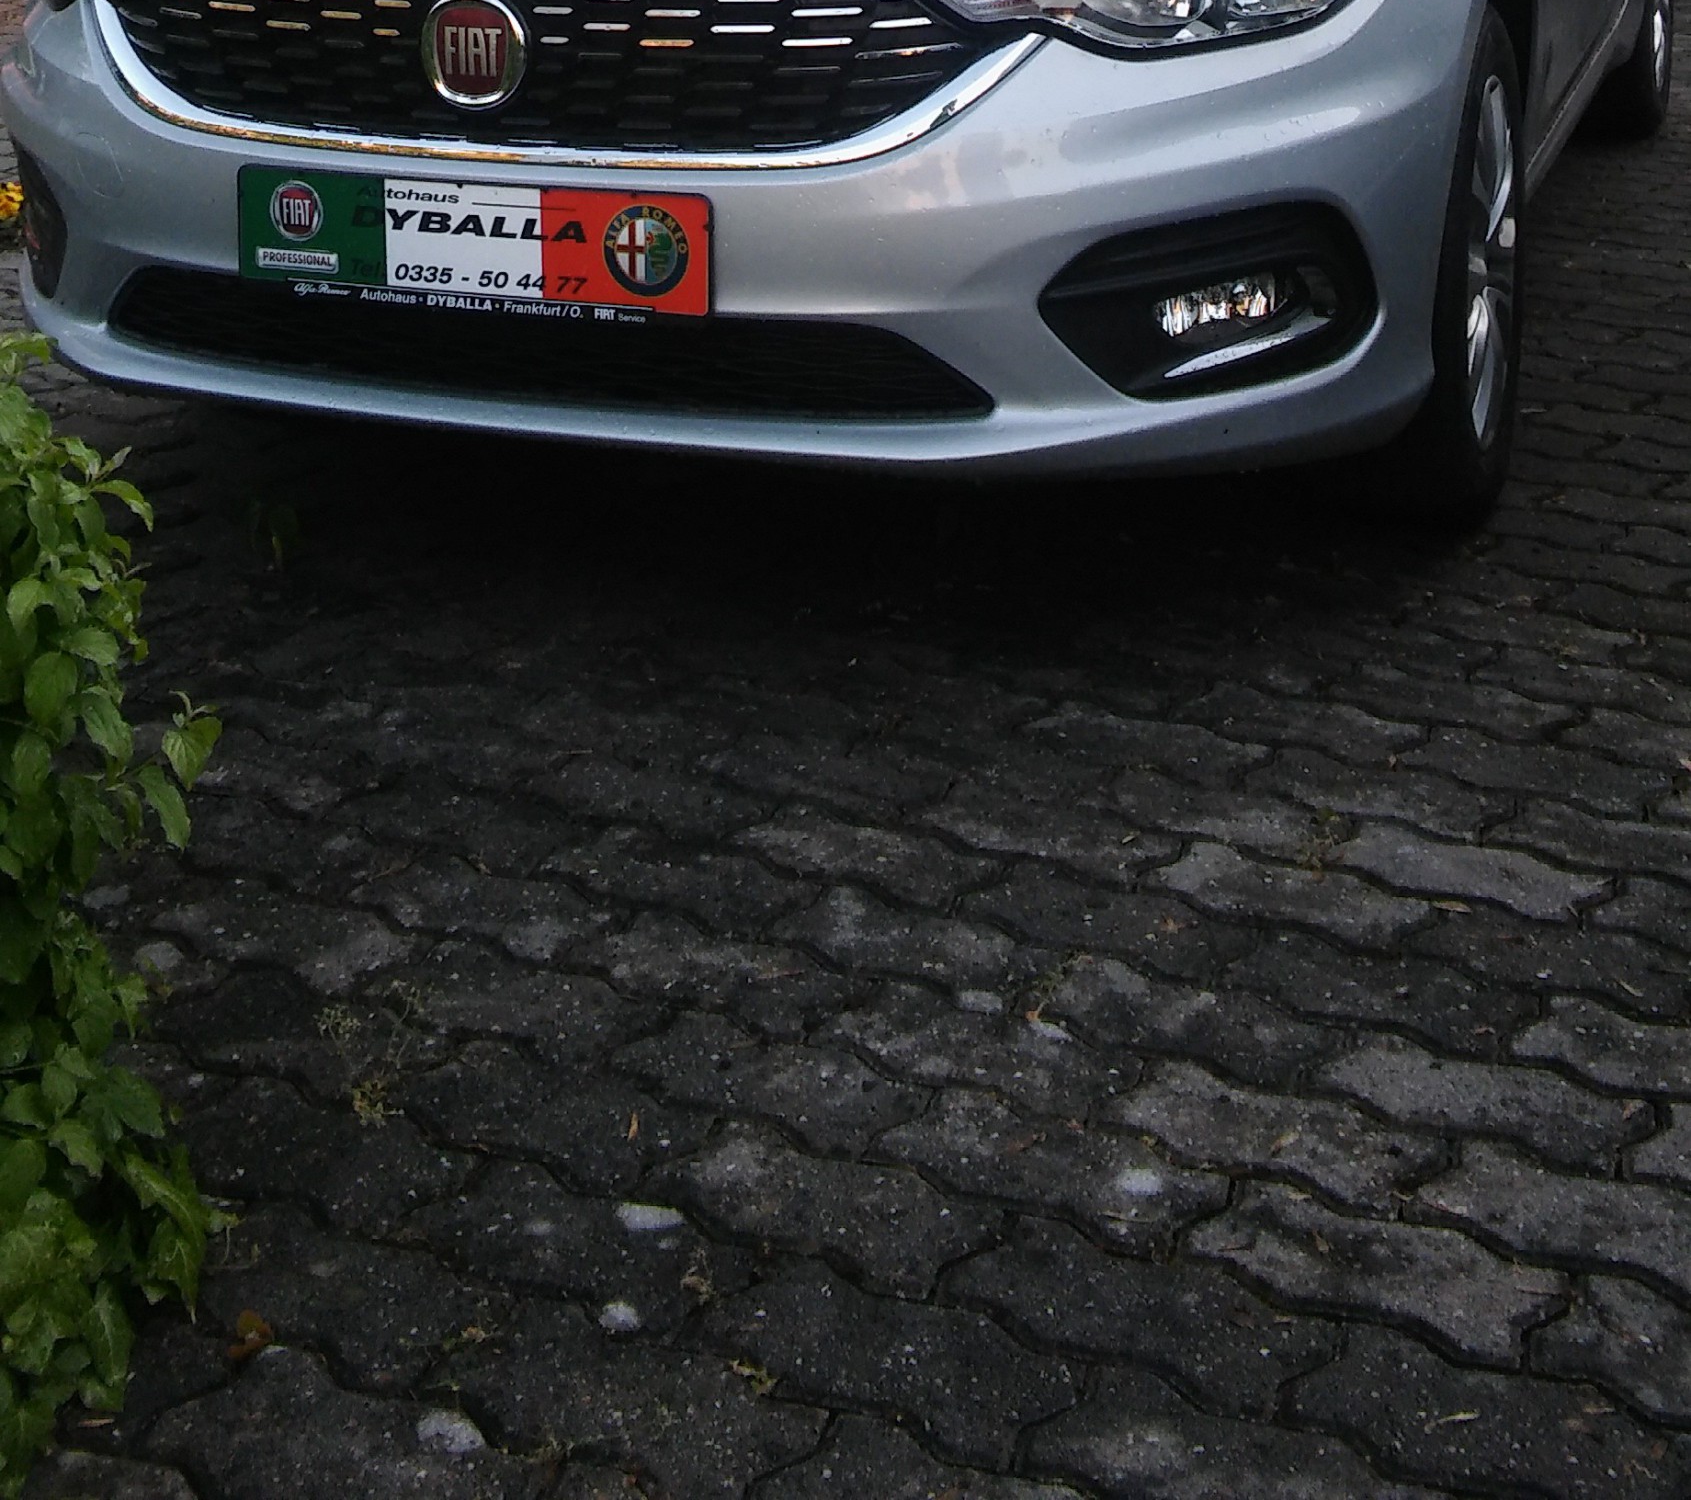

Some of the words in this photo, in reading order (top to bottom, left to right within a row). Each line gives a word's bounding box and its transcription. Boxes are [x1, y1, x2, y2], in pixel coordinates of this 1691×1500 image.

[444, 26, 502, 77] FIAT
[282, 197, 311, 227] FIAT
[352, 205, 588, 244] DYBALLA
[262, 251, 333, 267] PROFESSIONAL
[394, 263, 453, 285] 0335
[478, 271, 509, 290] 50
[516, 273, 547, 292] 44
[556, 276, 588, 295] 77
[360, 288, 417, 304] Autohaus
[426, 294, 493, 312] DYBALLA
[594, 308, 616, 321] FIAT
[617, 313, 647, 324] Service
